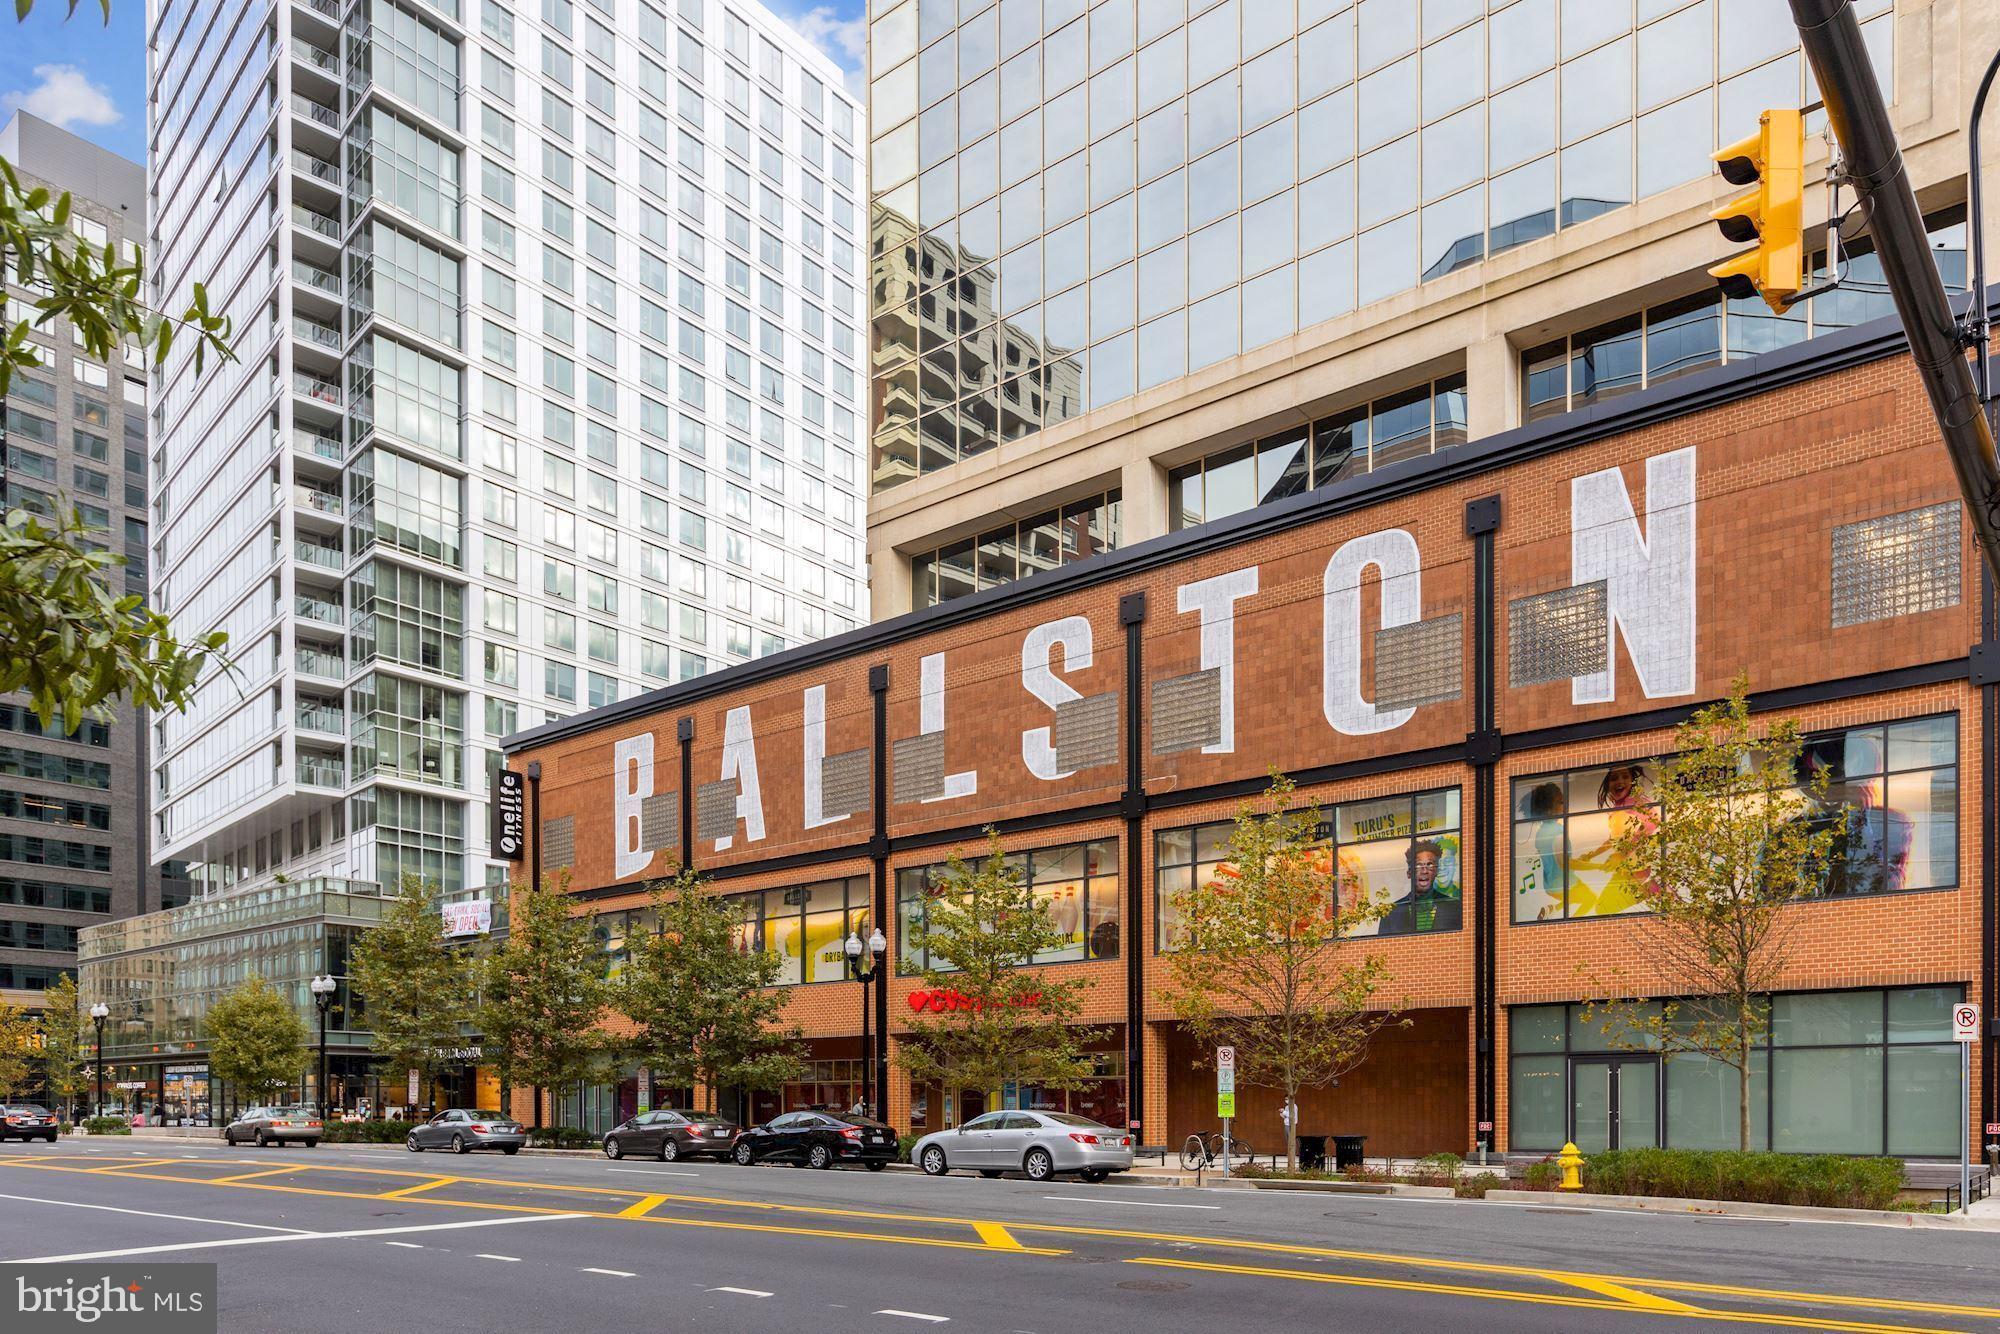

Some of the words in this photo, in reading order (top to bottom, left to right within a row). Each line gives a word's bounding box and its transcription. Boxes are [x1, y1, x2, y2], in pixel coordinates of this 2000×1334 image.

[613, 446, 1696, 880] BALLSTON
[1354, 813, 1395, 836] TURU'S
[1396, 824, 1415, 837] PIZZ
[1029, 1102, 1056, 1110] beverage
